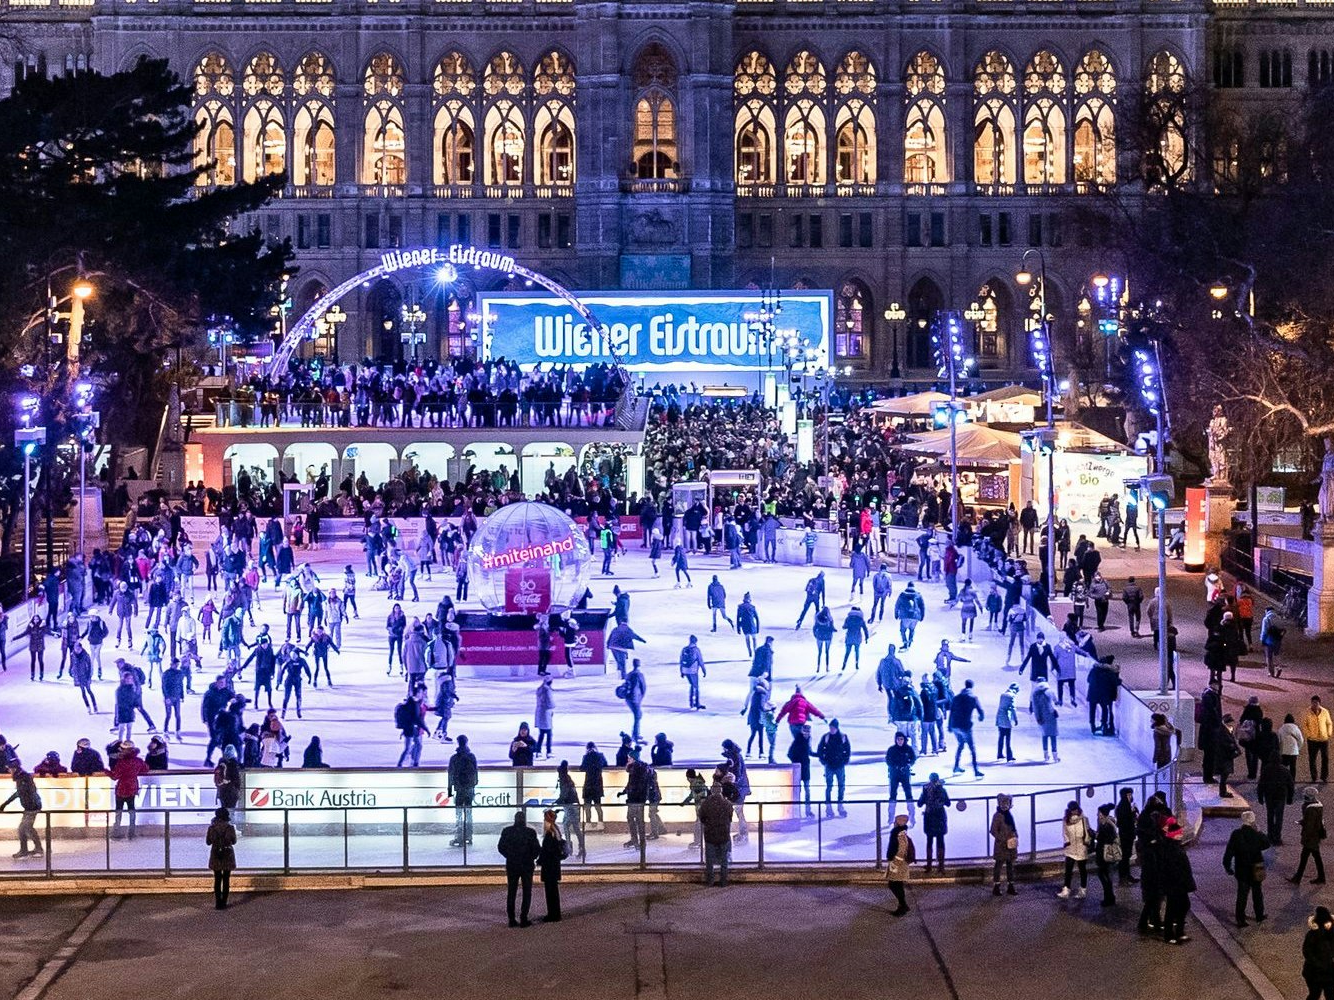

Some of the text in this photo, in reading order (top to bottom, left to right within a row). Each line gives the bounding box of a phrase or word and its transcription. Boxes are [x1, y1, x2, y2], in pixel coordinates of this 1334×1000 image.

[381, 244, 514, 273] Wiener Eistraum
[535, 313, 642, 357] Wiener
[1080, 472, 1099, 485] Bio
[272, 789, 314, 807] Bank
[320, 789, 377, 807] Austria
